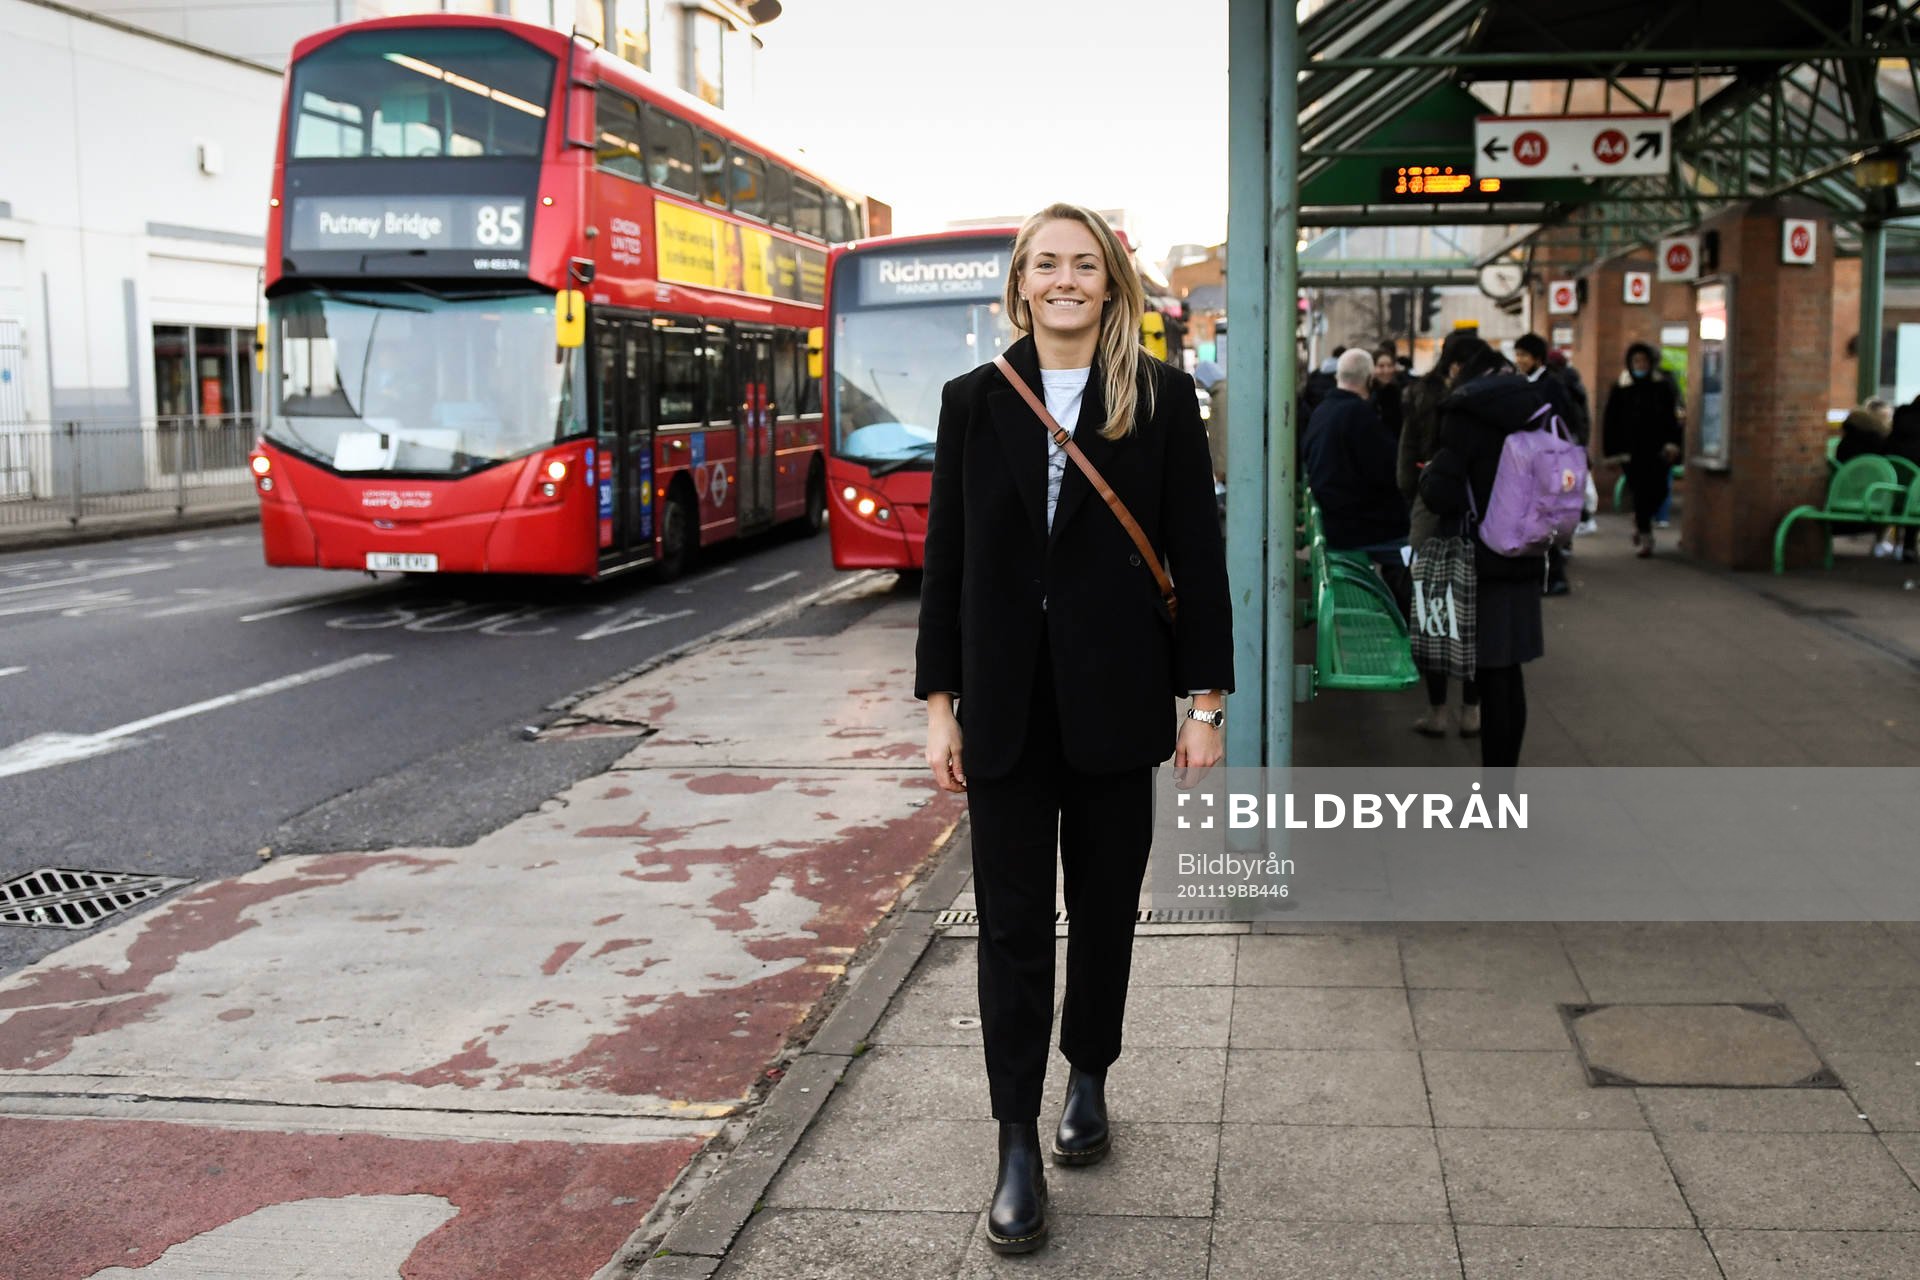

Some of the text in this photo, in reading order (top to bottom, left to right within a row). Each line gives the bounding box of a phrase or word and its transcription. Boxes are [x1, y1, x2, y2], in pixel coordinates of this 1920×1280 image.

[319, 211, 442, 240] Putney Bridge
[476, 205, 522, 245] 85
[879, 255, 1000, 284] Richmond
[895, 280, 983, 295] MANOR CIRCUS
